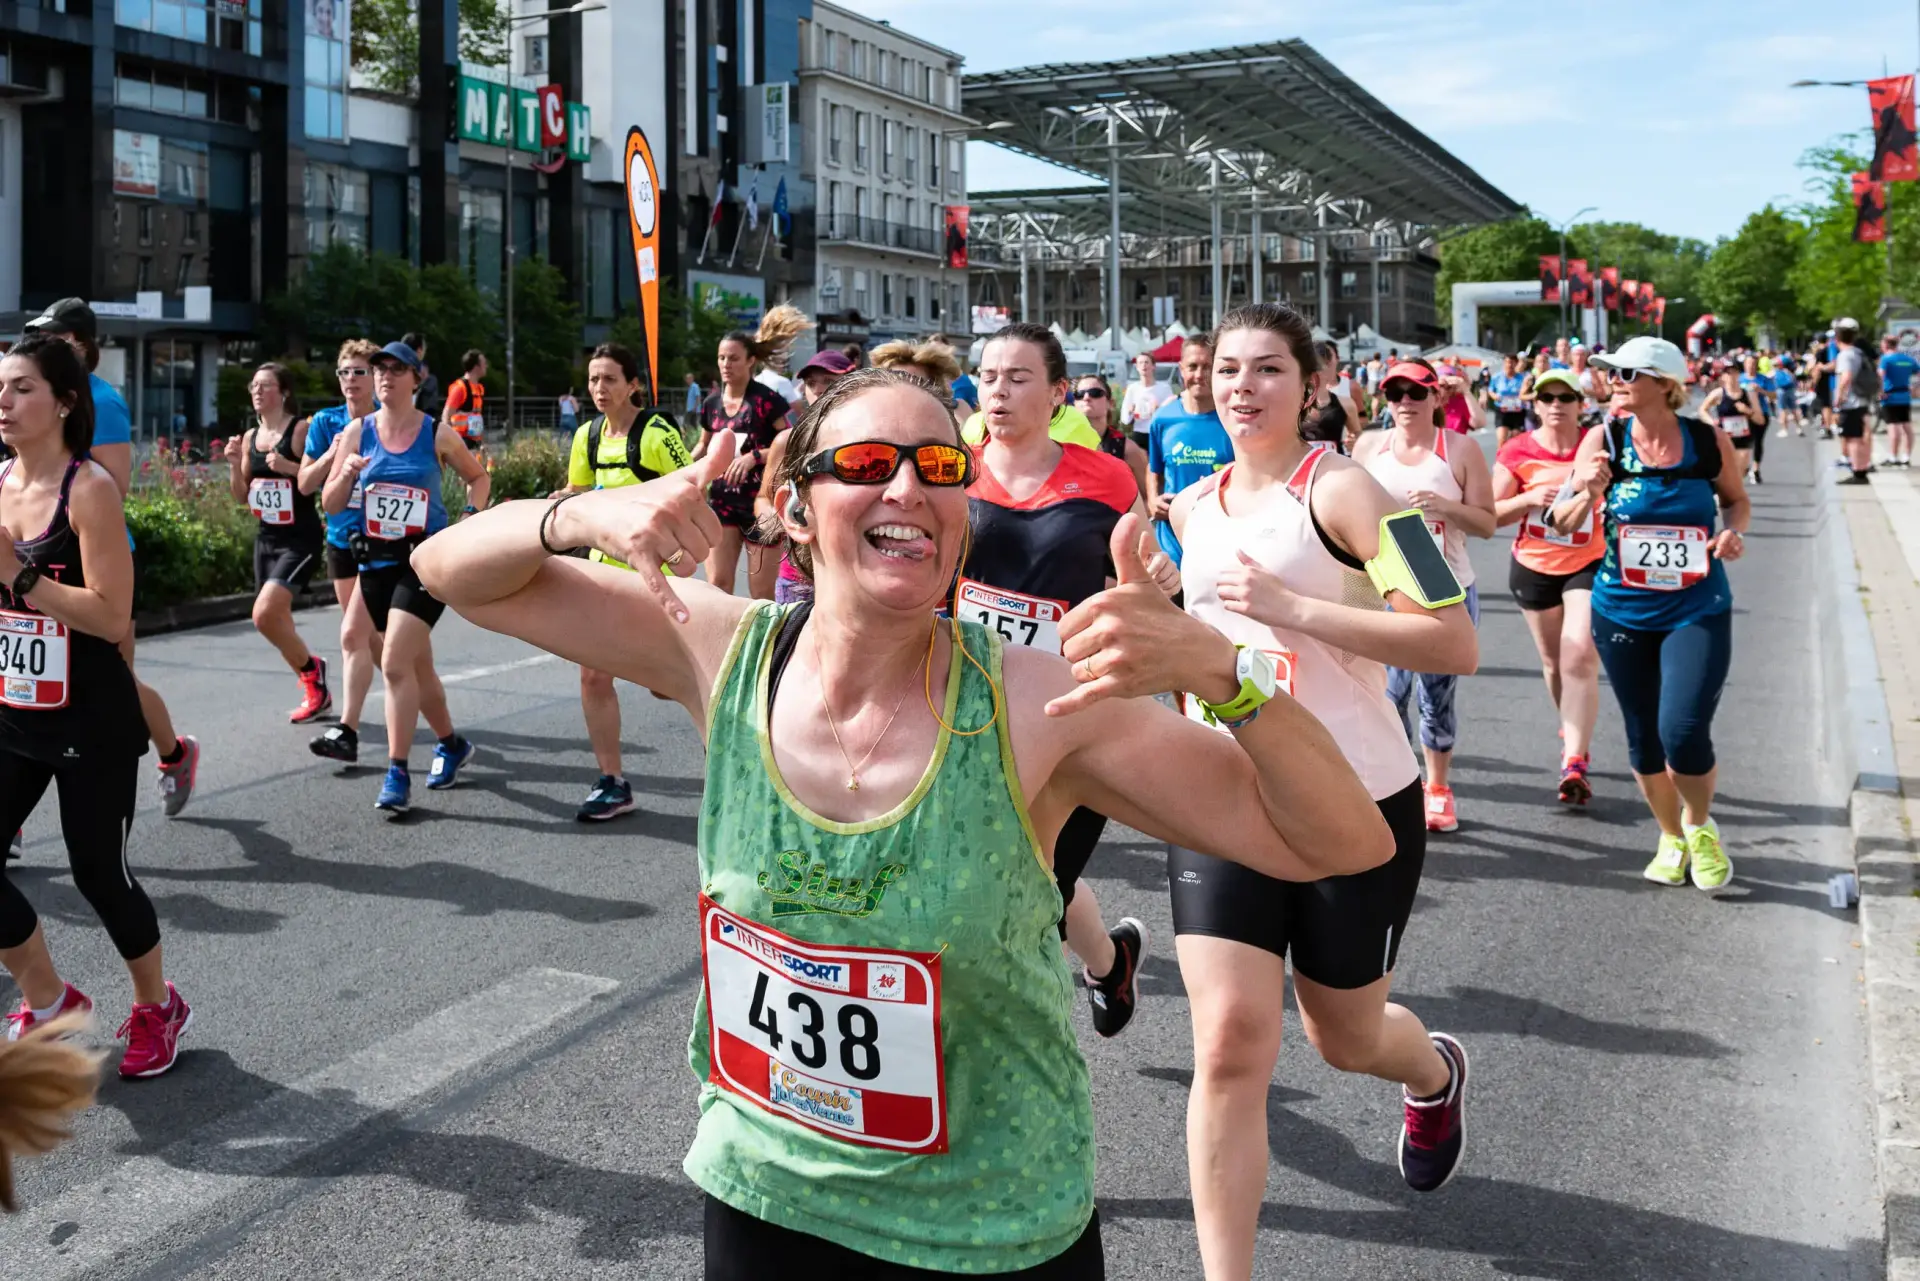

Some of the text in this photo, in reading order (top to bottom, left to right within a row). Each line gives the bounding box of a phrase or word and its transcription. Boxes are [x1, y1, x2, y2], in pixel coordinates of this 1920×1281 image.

[464, 87, 591, 156] MATCH
[256, 490, 282, 509] 433
[376, 496, 414, 522] 527
[1638, 542, 1689, 568] 233
[974, 590, 1027, 611] INTERSPORT
[0, 619, 35, 630] NTERSPORT
[0, 634, 46, 676] 340
[736, 928, 842, 983] INTERSPORT
[749, 971, 881, 1080] 438
[781, 1070, 853, 1112] Courir
